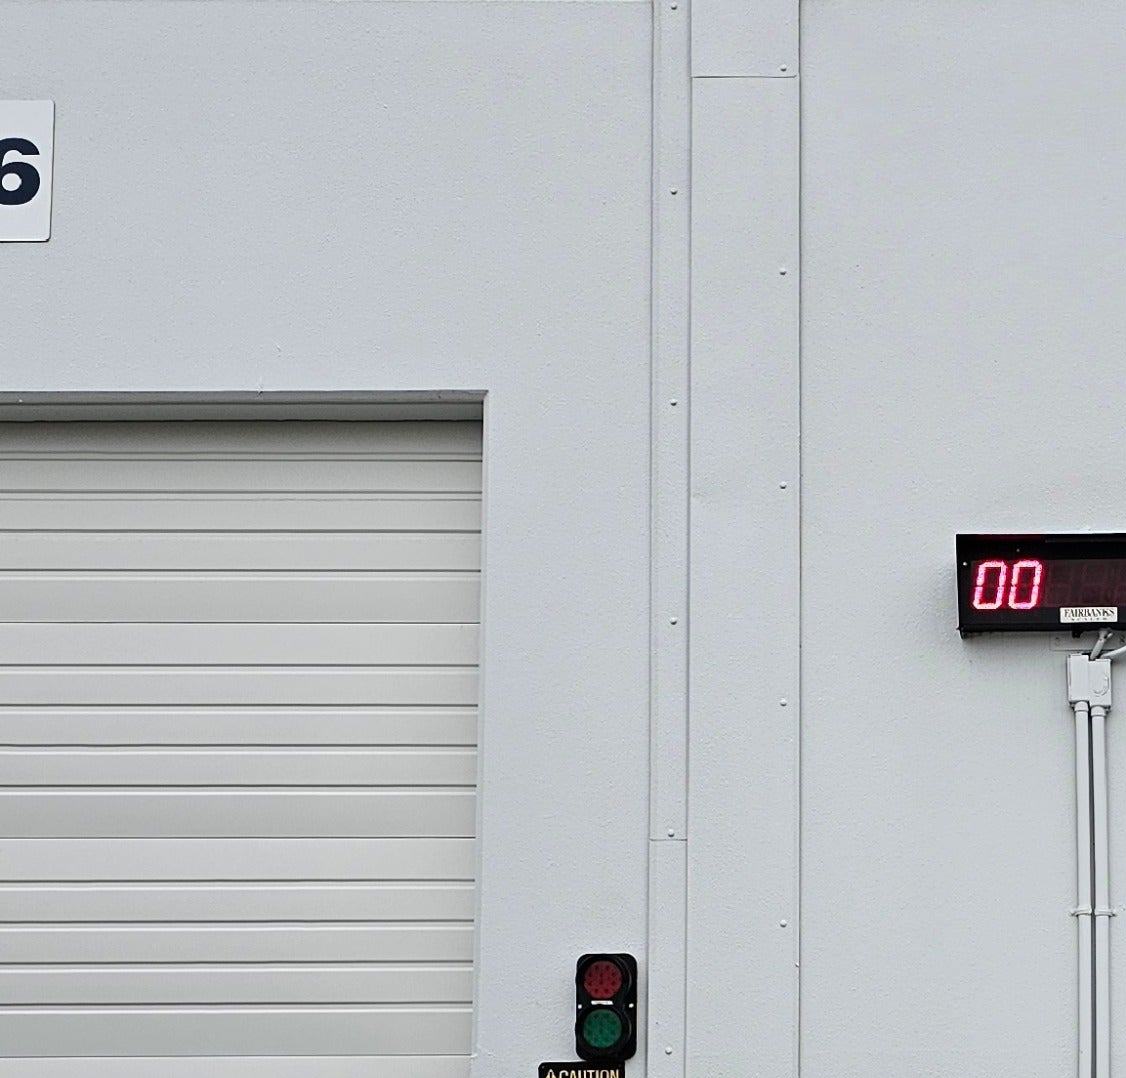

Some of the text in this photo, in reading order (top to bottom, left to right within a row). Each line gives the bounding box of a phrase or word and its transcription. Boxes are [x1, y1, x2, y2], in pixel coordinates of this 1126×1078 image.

[0, 137, 41, 206] 6
[972, 559, 1044, 610] 00
[1064, 608, 1115, 618] FAIRBANKS
